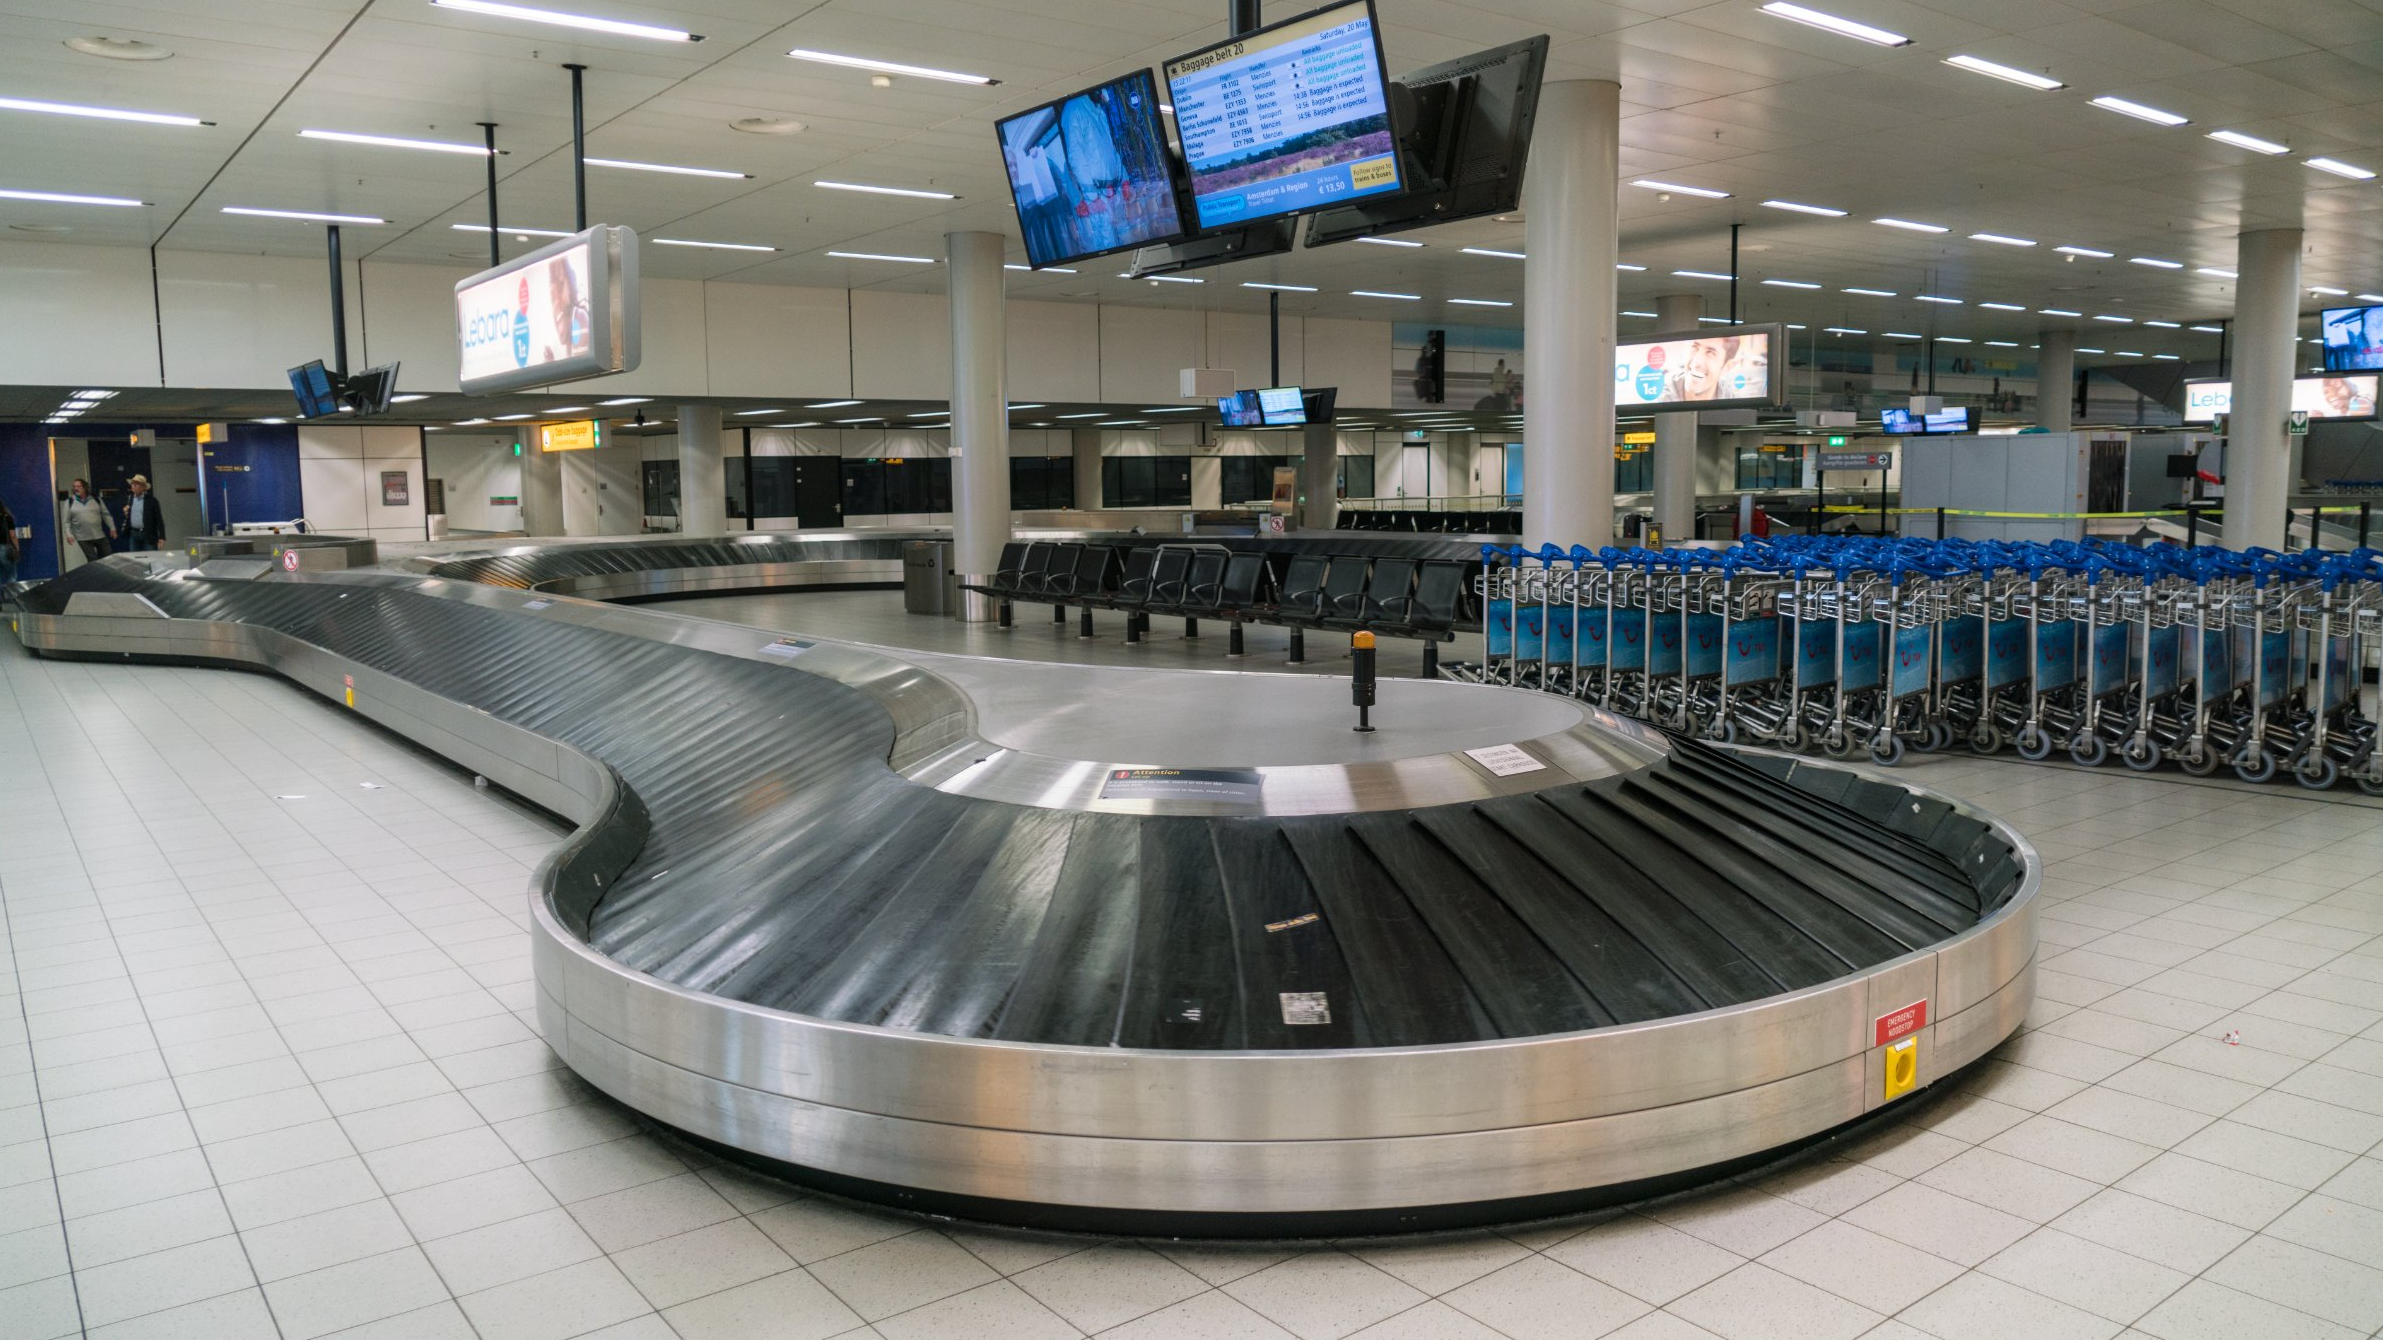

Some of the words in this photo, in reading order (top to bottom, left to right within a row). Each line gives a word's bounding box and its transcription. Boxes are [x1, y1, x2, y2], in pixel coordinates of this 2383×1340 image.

[1356, 19, 1368, 30] May
[1180, 55, 1215, 73] Baggage
[1215, 48, 1232, 60] belt
[1233, 42, 1244, 55] 20
[1312, 51, 1336, 63] baggage
[1336, 43, 1362, 54] unloaded
[1178, 101, 1205, 112] Manchester
[1313, 61, 1337, 73] baggage
[1338, 53, 1364, 64] unloaded
[1309, 84, 1333, 96] Baggage
[1338, 76, 1363, 87] expected
[1180, 113, 1198, 122] Geneva
[1315, 72, 1339, 84] baggage
[1340, 64, 1366, 75] unloaded
[1184, 129, 1216, 140] Southampton
[1311, 95, 1335, 107] Baggage
[1340, 86, 1365, 98] expected
[1313, 105, 1337, 117] Baggage
[1342, 97, 1367, 108] expected
[1370, 164, 1385, 173] signs
[1246, 188, 1279, 199] Amsterdam
[1286, 182, 1308, 192] Region
[1318, 186, 1325, 194] €
[1326, 182, 1345, 192] 13,50
[1217, 197, 1241, 208] Transport
[465, 308, 509, 348] Lebara
[2192, 392, 2233, 407] Leb
[1888, 1010, 1916, 1028] EMERGENCY
[1888, 1020, 1914, 1037] NOODSTOP
